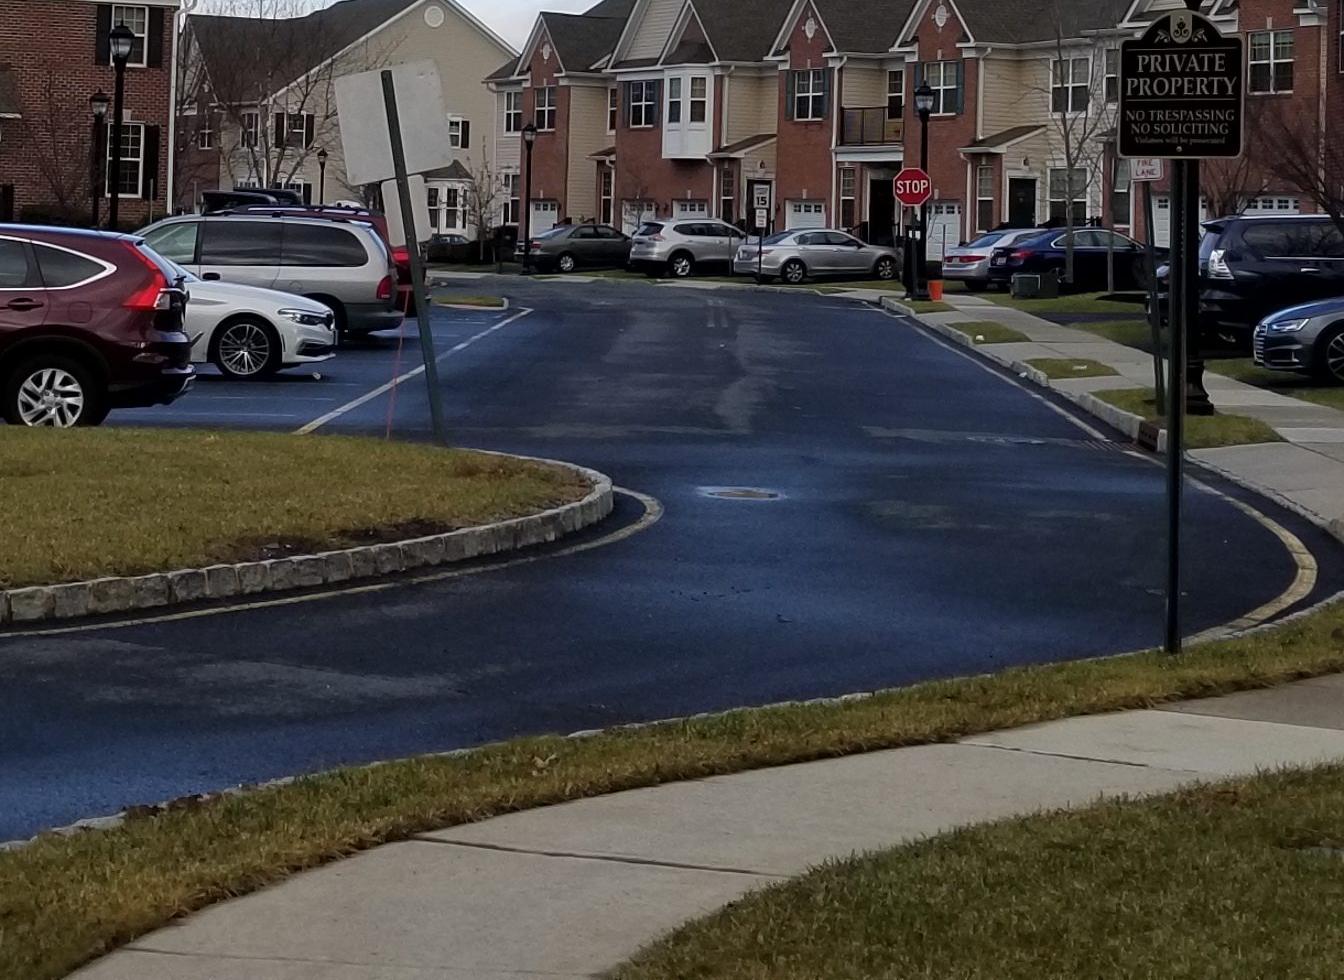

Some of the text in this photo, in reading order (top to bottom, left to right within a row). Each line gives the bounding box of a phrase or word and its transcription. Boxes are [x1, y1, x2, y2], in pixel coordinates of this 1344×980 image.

[1137, 53, 1226, 73] PRIVATE
[1126, 76, 1237, 96] PROPERTY
[1126, 109, 1235, 121] NO TRESPASSING
[1131, 123, 1229, 134] NO SOLICITING
[1136, 168, 1156, 177] LANE
[896, 180, 928, 194] STOP
[756, 196, 767, 205] 15
